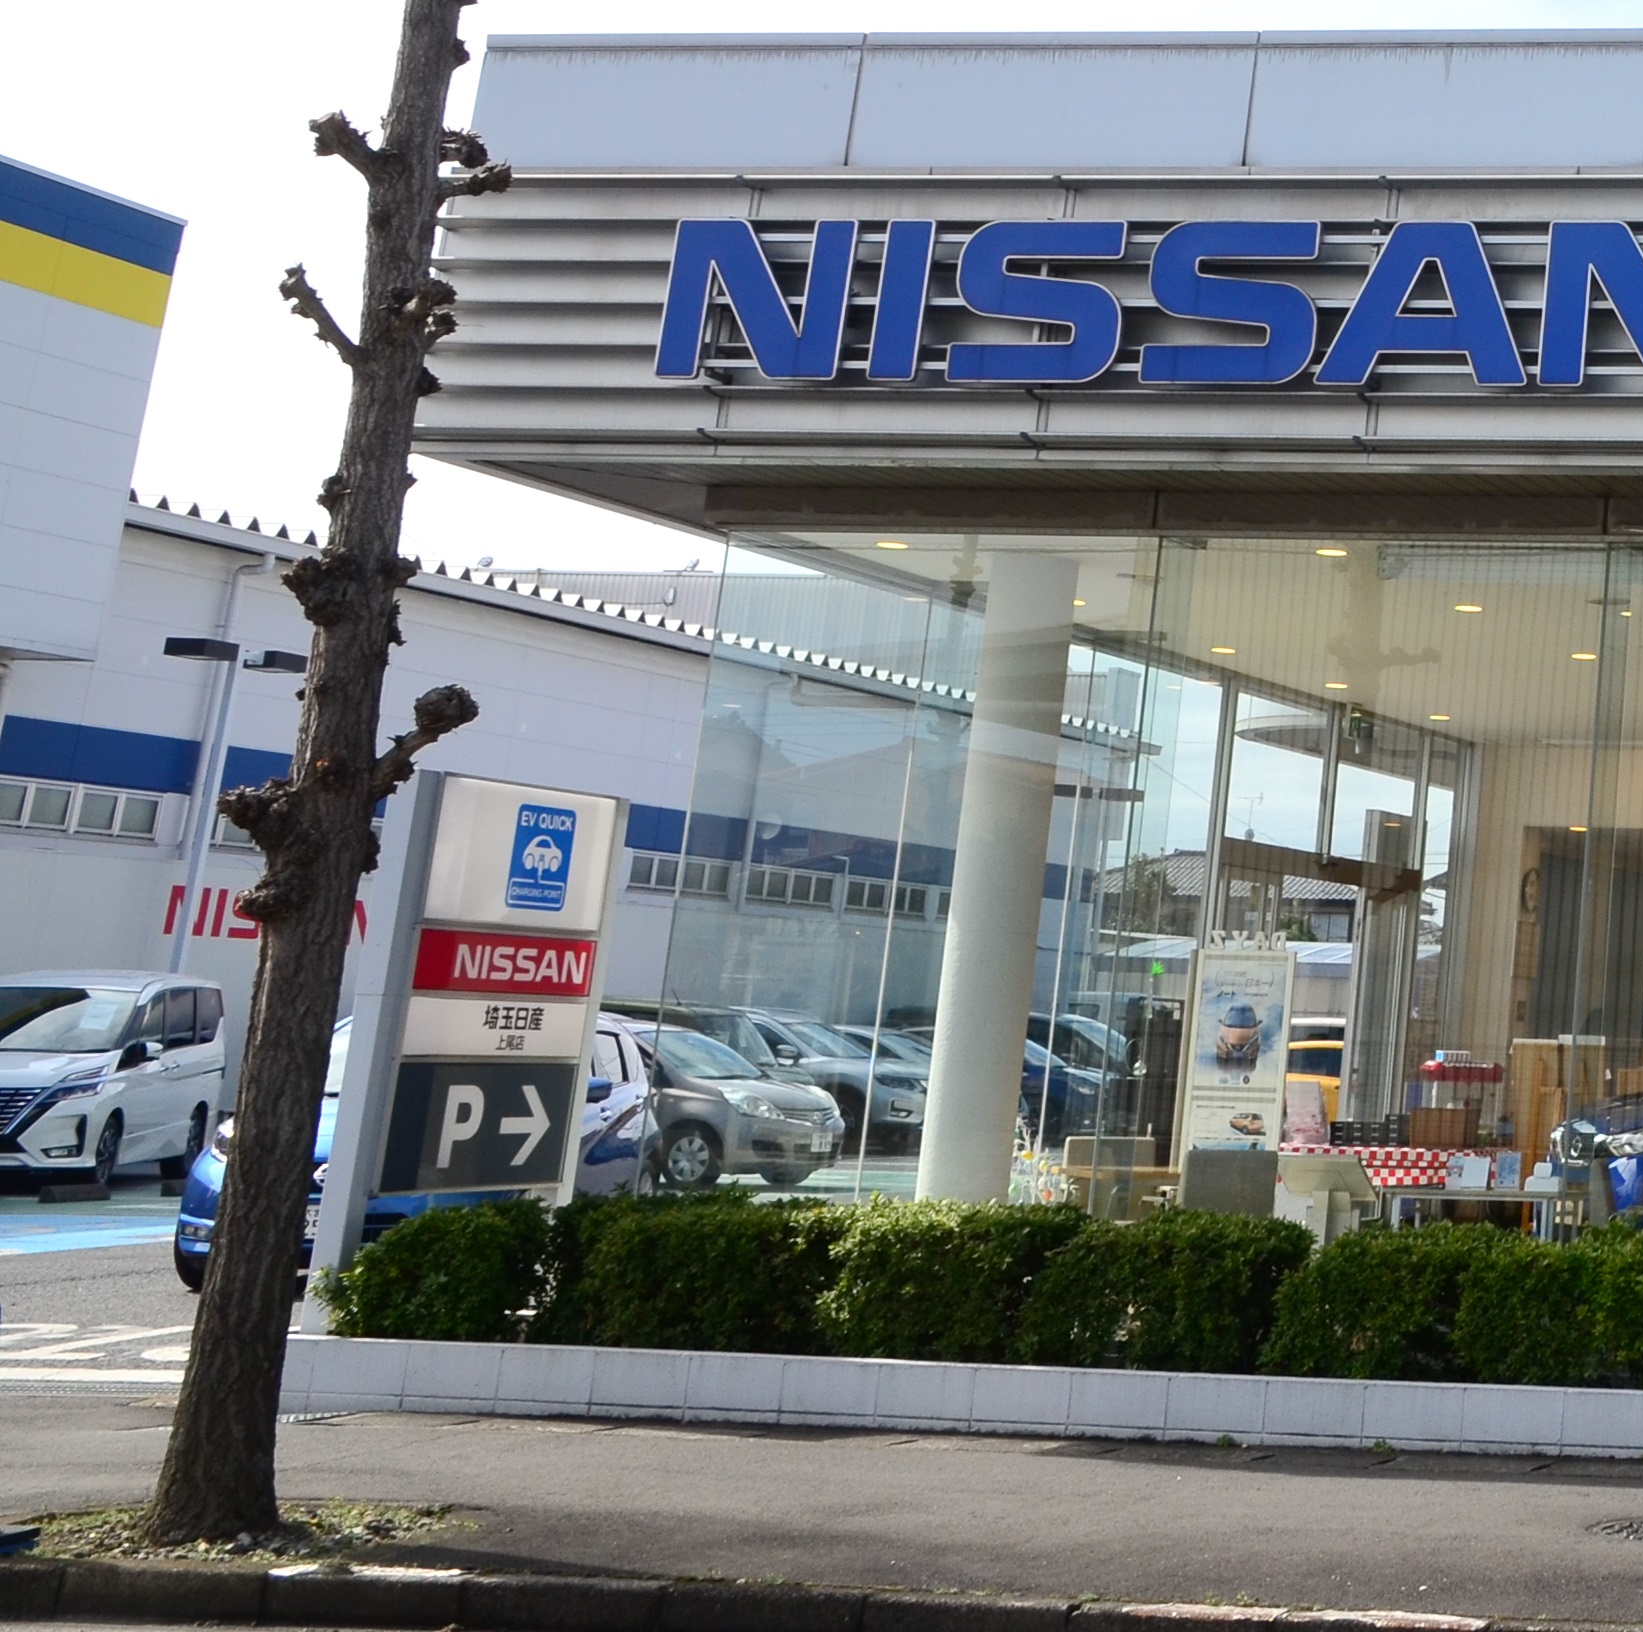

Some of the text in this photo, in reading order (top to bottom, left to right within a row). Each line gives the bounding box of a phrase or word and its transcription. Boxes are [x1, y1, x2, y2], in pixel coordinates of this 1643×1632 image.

[520, 810, 573, 831] EV QUICK
[511, 885, 562, 899] CHARGING POINT
[454, 944, 587, 985] NISSAN
[483, 1005, 545, 1030] 埼玉日産
[495, 1034, 526, 1051] 上尾店
[436, 1085, 485, 1169] P
